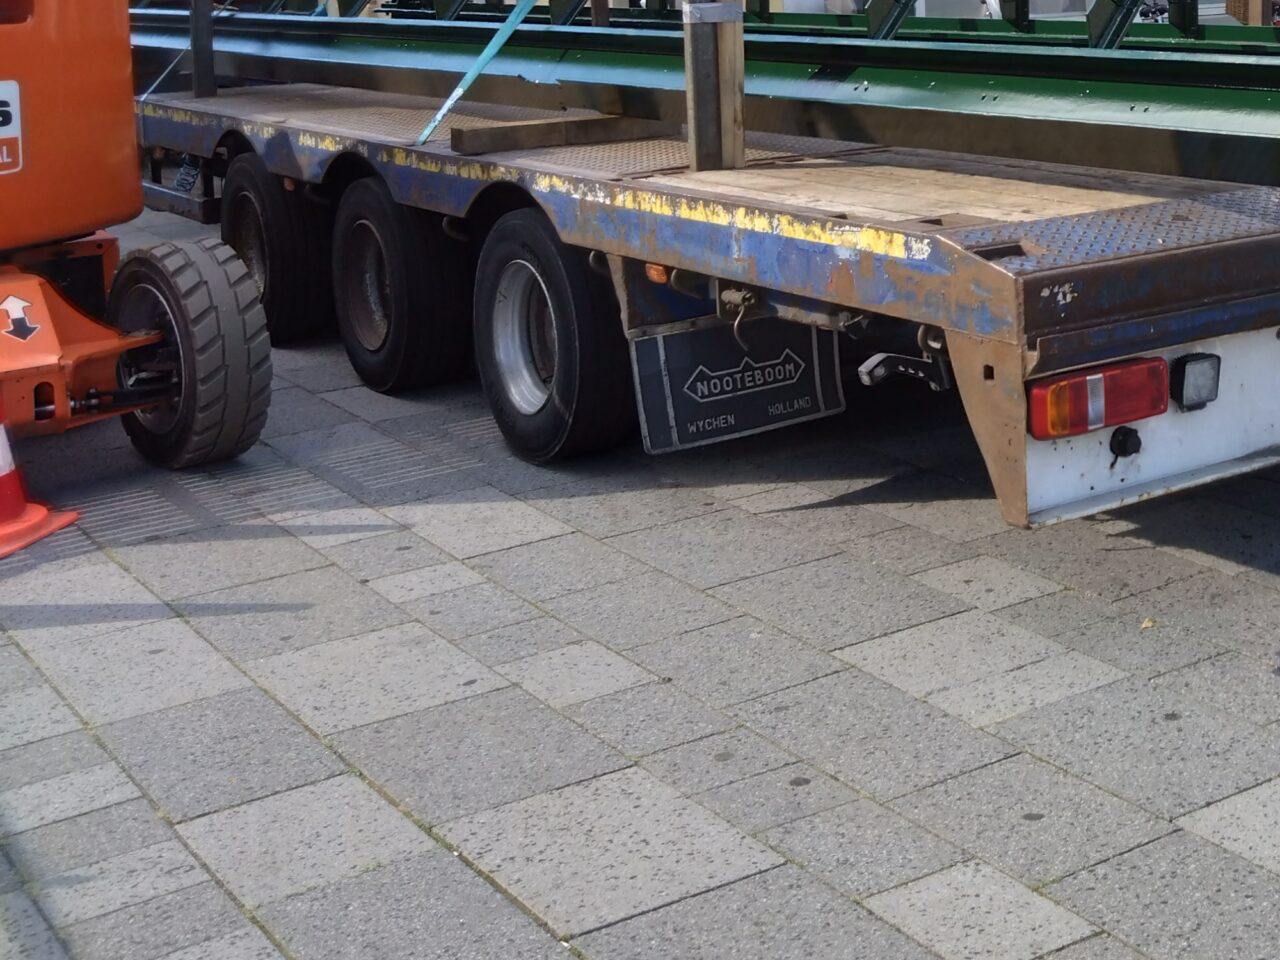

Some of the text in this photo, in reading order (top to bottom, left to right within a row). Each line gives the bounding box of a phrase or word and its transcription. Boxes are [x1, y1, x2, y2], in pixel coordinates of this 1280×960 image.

[696, 362, 795, 397] NOOTEBOOM
[687, 396, 812, 434] WYCHEN HOLLAND
